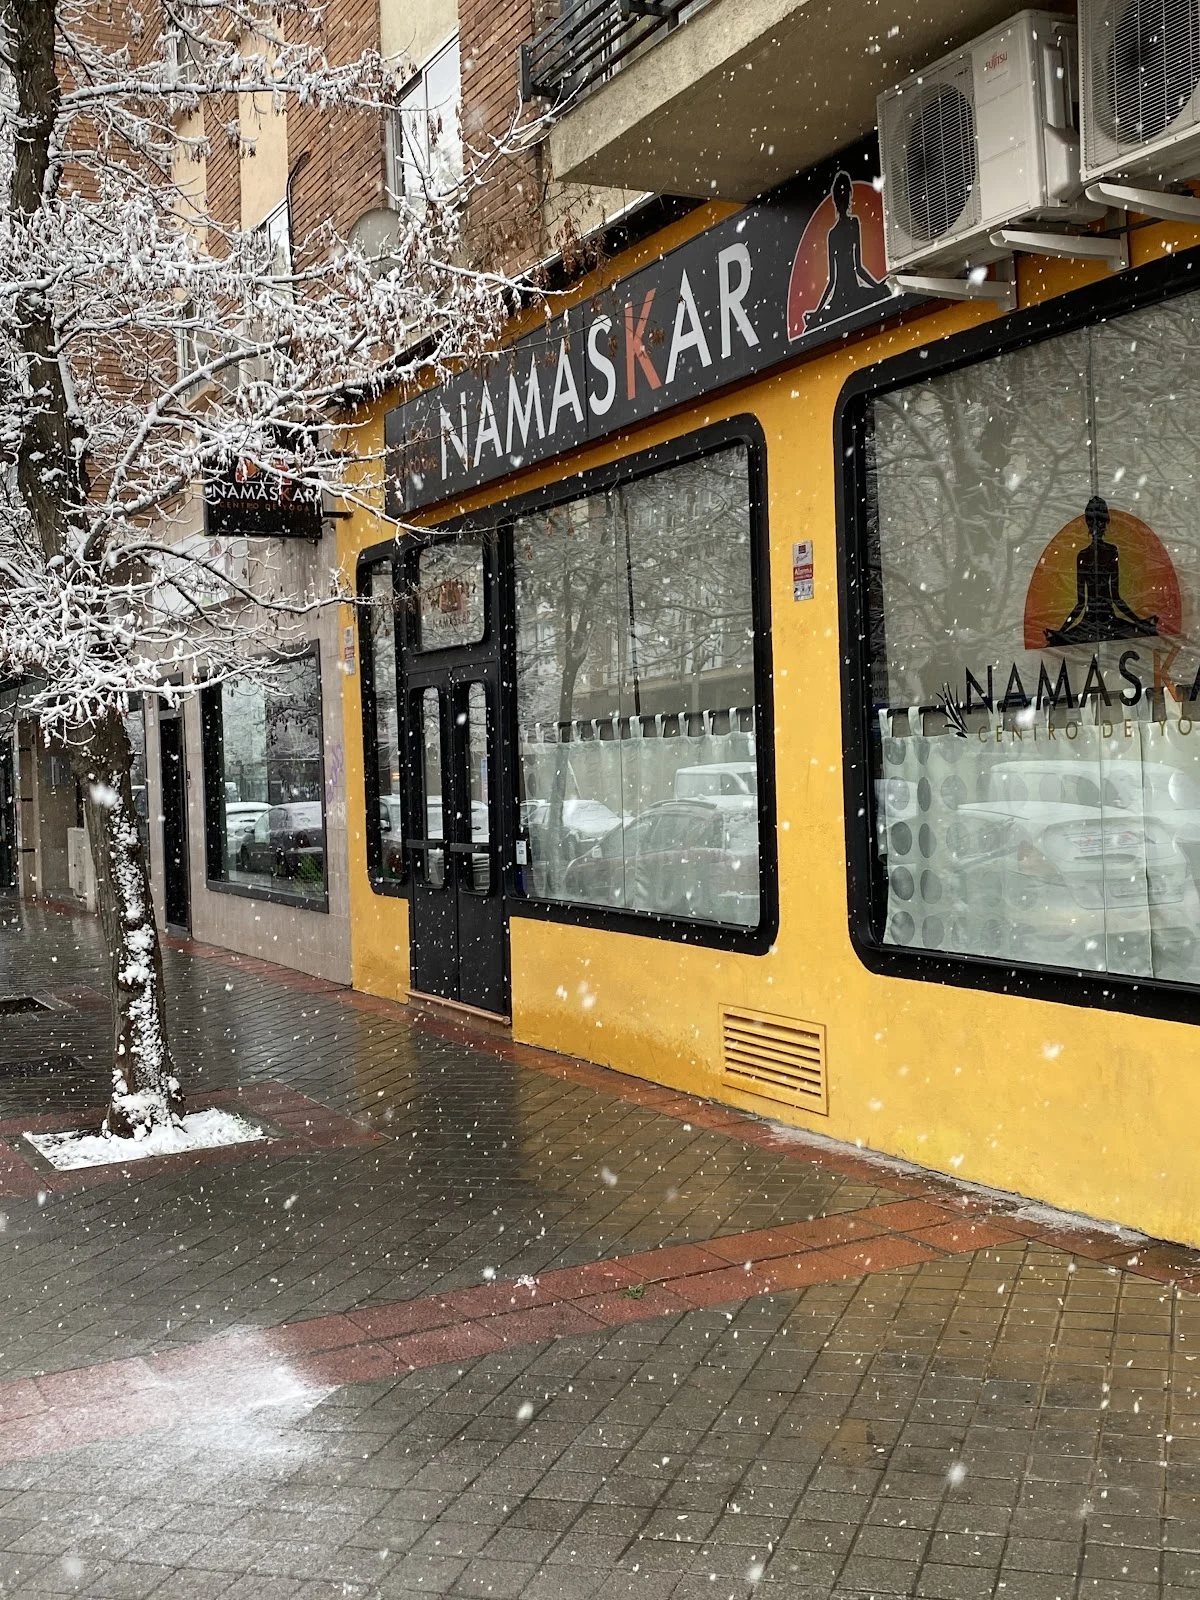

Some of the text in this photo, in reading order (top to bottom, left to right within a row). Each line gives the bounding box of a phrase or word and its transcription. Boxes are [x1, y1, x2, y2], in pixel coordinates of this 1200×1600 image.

[985, 51, 1008, 70] FUJITSU
[439, 242, 760, 481] NAMASKAR
[212, 484, 316, 503] NAMASKAR
[219, 501, 259, 510] CENTRO
[282, 504, 310, 513] YOGA
[978, 722, 1078, 743] CENTRO
[1102, 719, 1133, 739] DE
